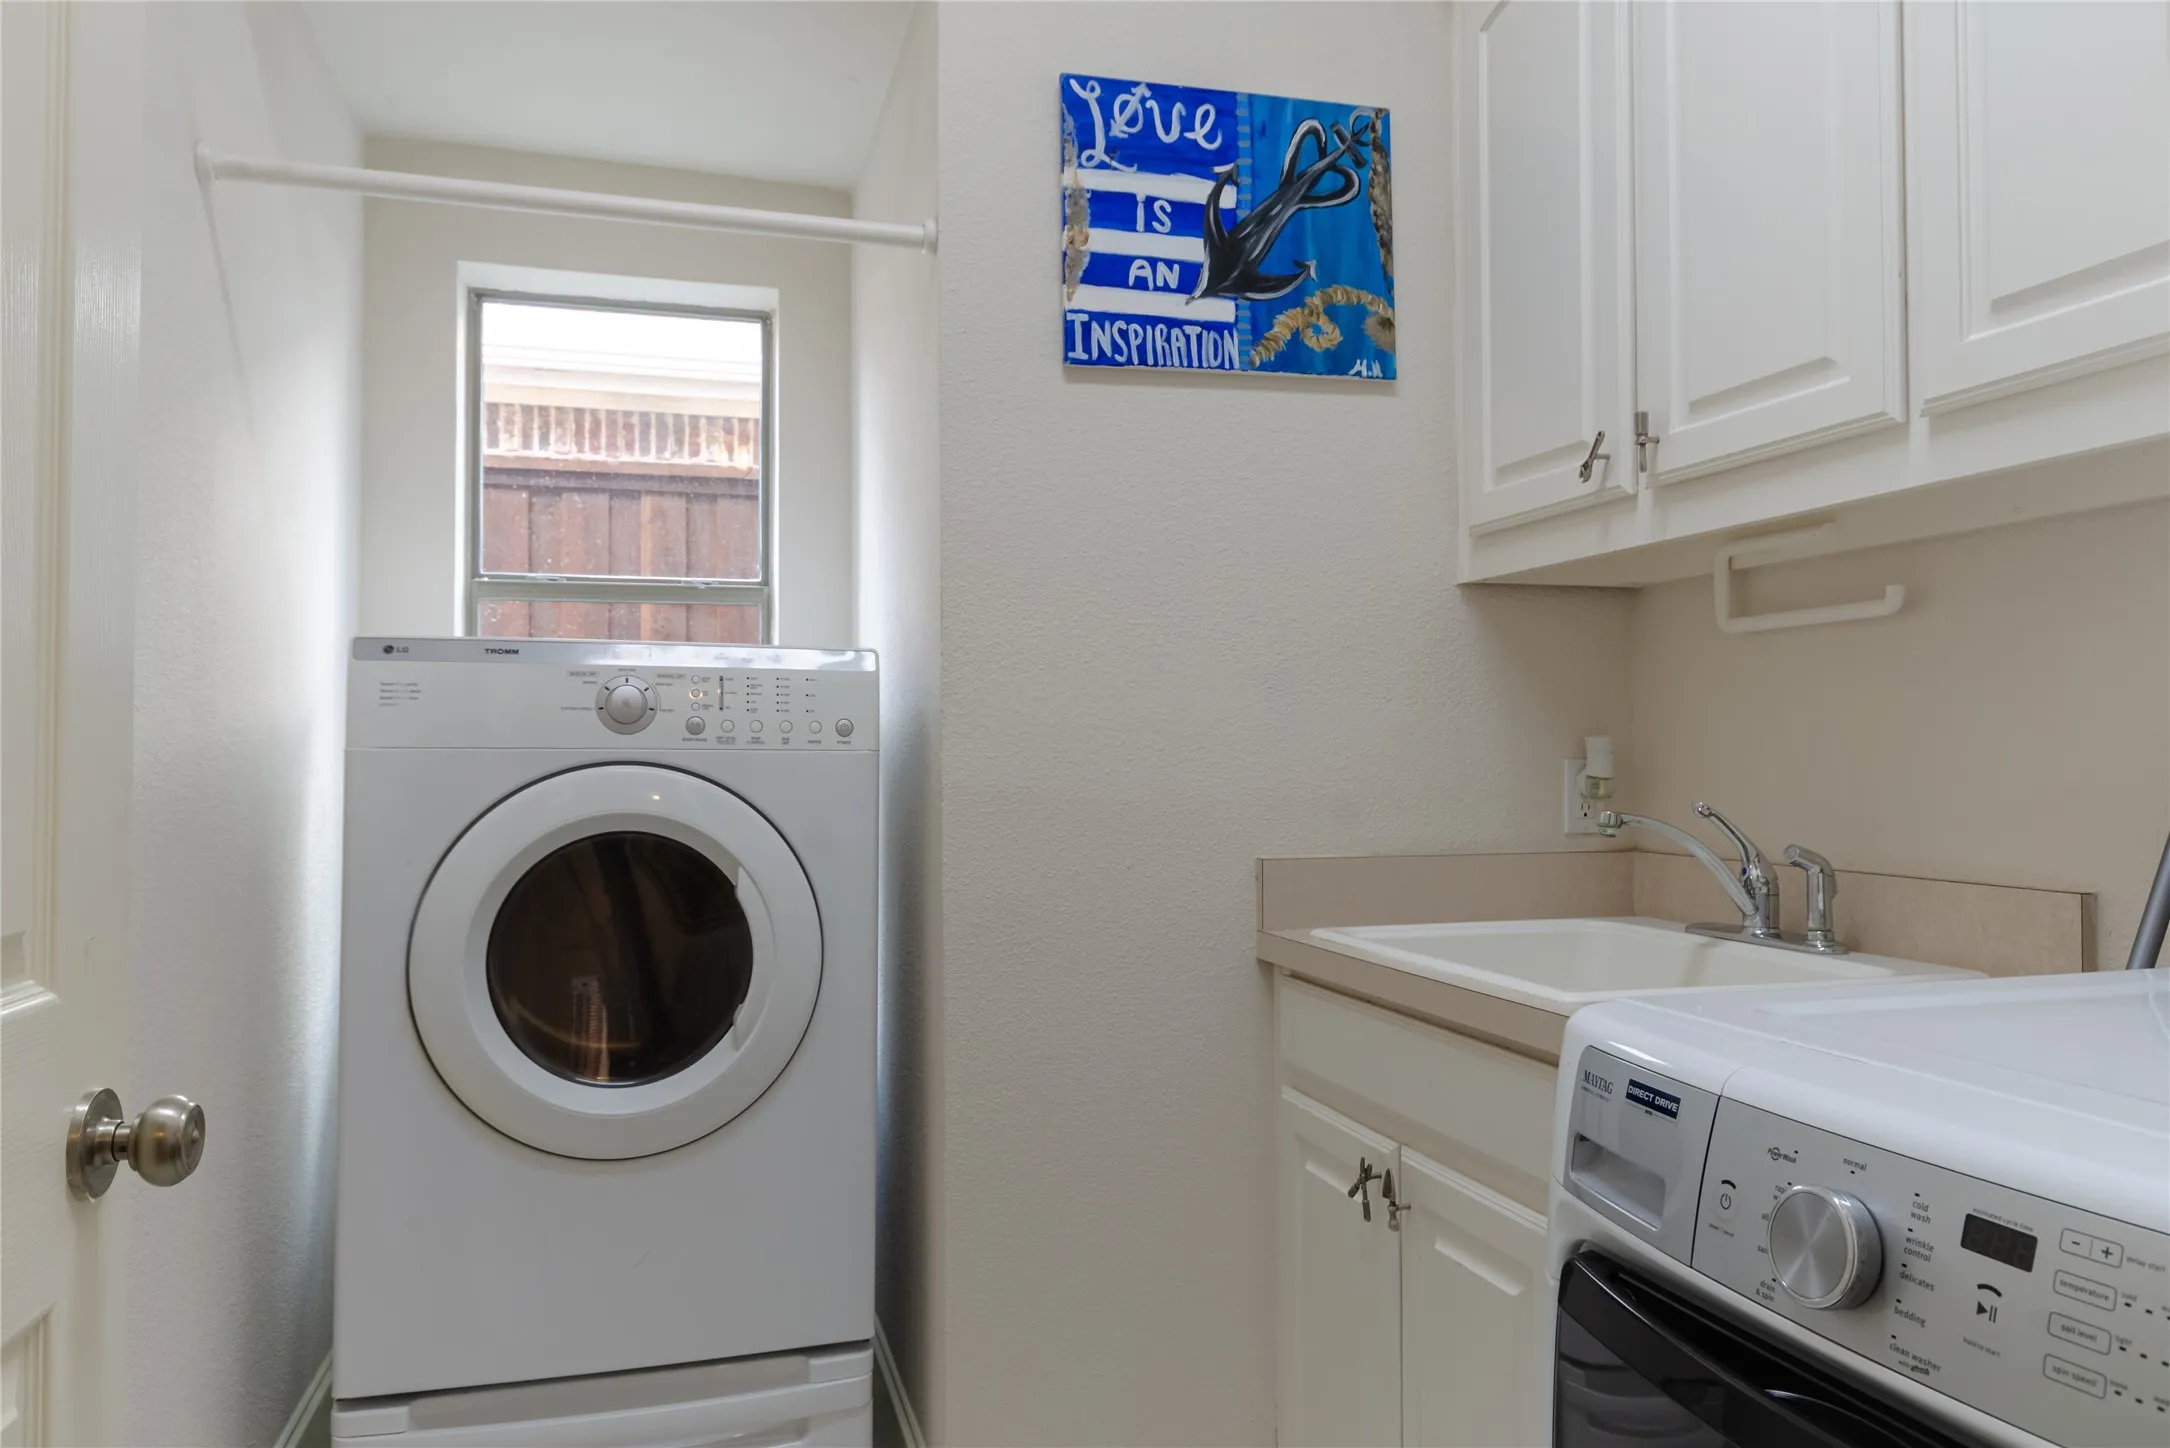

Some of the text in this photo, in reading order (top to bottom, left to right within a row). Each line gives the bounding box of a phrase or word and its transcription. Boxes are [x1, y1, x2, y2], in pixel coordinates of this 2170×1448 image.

[1136, 193, 1172, 233] IS
[1129, 259, 1180, 290] AN
[1067, 313, 1240, 370] INSPIRATION
[1582, 1069, 1614, 1095] MAYTAG
[1627, 1085, 1654, 1102] DIRECT
[1654, 1096, 1679, 1113] DRIVE
[1842, 1157, 1867, 1171] normal
[1912, 1200, 1929, 1212] cold
[1910, 1211, 1931, 1224] wash
[1903, 1245, 1932, 1263] control
[1905, 1235, 1935, 1252] wrinkle
[1760, 1280, 1776, 1293] drain
[1900, 1270, 1935, 1292] delicates
[2059, 1278, 2110, 1302] temperature
[1761, 1290, 1775, 1302] spin
[1894, 1305, 1926, 1328] bedding
[2061, 1323, 2097, 1342] soil level
[1889, 1342, 1942, 1373] clean washer
[2052, 1364, 2070, 1378] spin
[2071, 1371, 2098, 1387] speed
